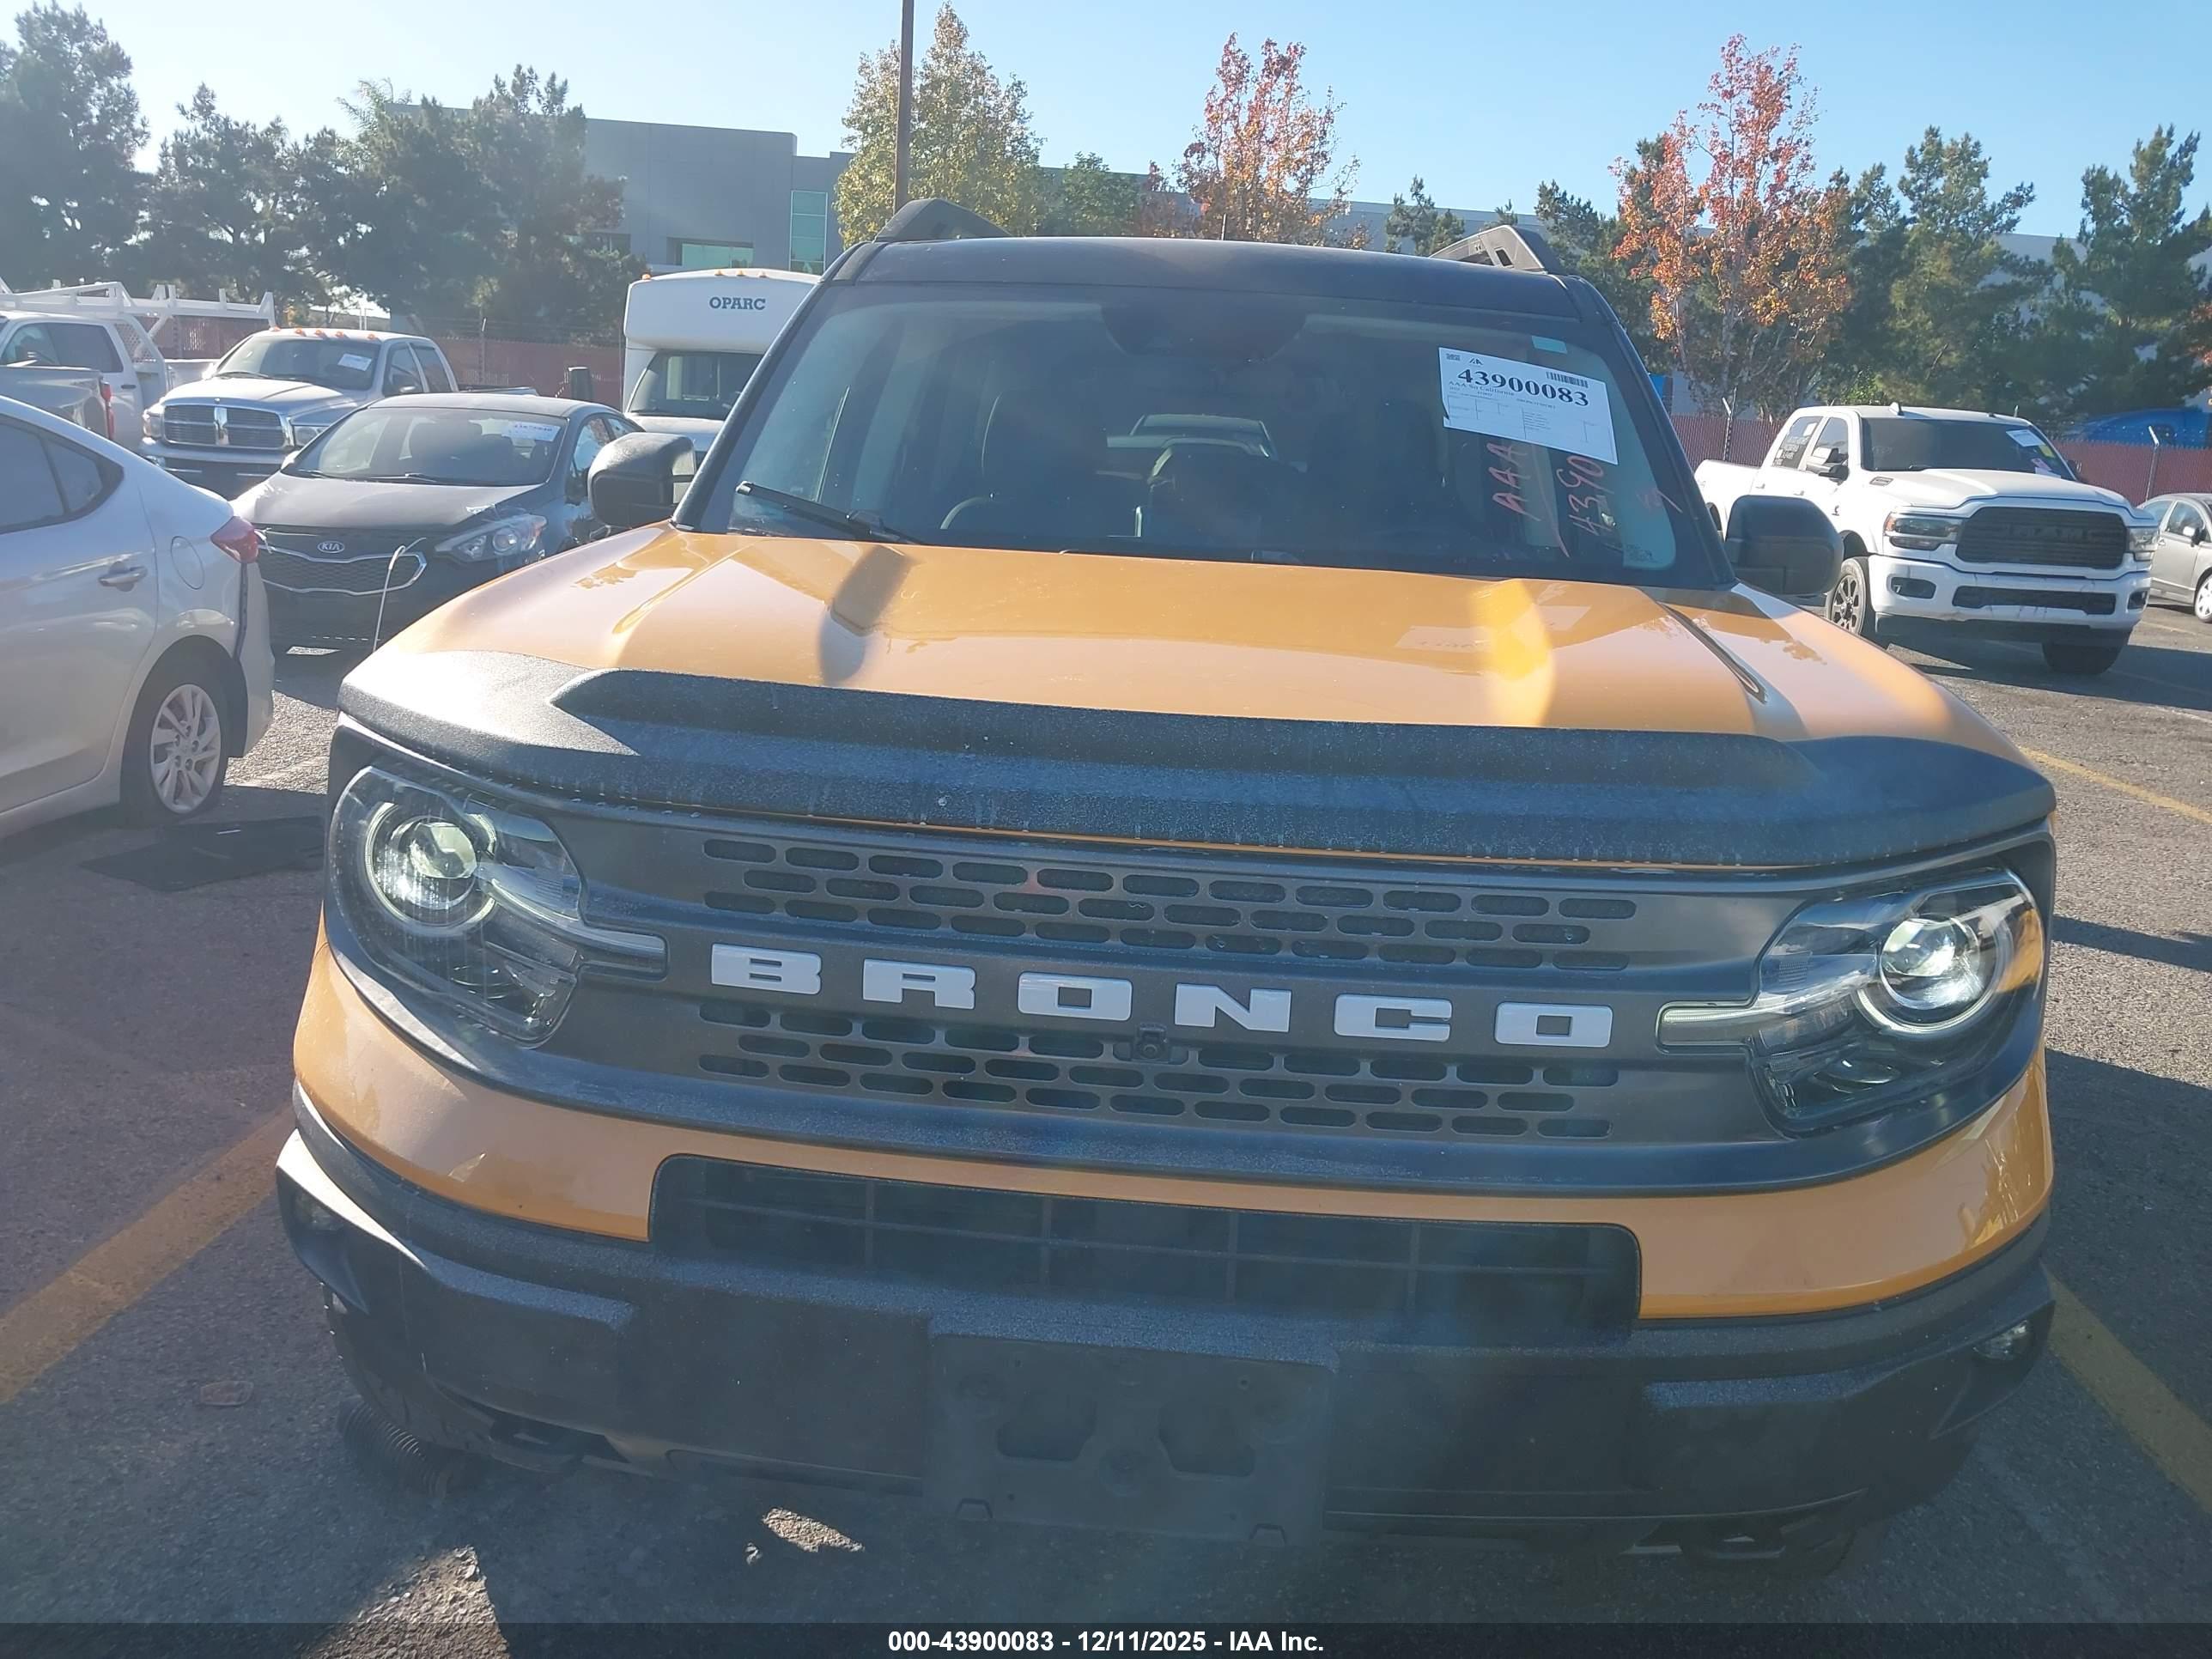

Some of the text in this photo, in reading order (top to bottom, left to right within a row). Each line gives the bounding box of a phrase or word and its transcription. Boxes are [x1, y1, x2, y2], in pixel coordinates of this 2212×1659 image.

[708, 296, 766, 311] OPARC
[1457, 368, 1589, 407] 43900083
[1486, 442, 1541, 522] AAA
[321, 542, 341, 550] KIA
[710, 942, 1613, 1049] BRONCO
